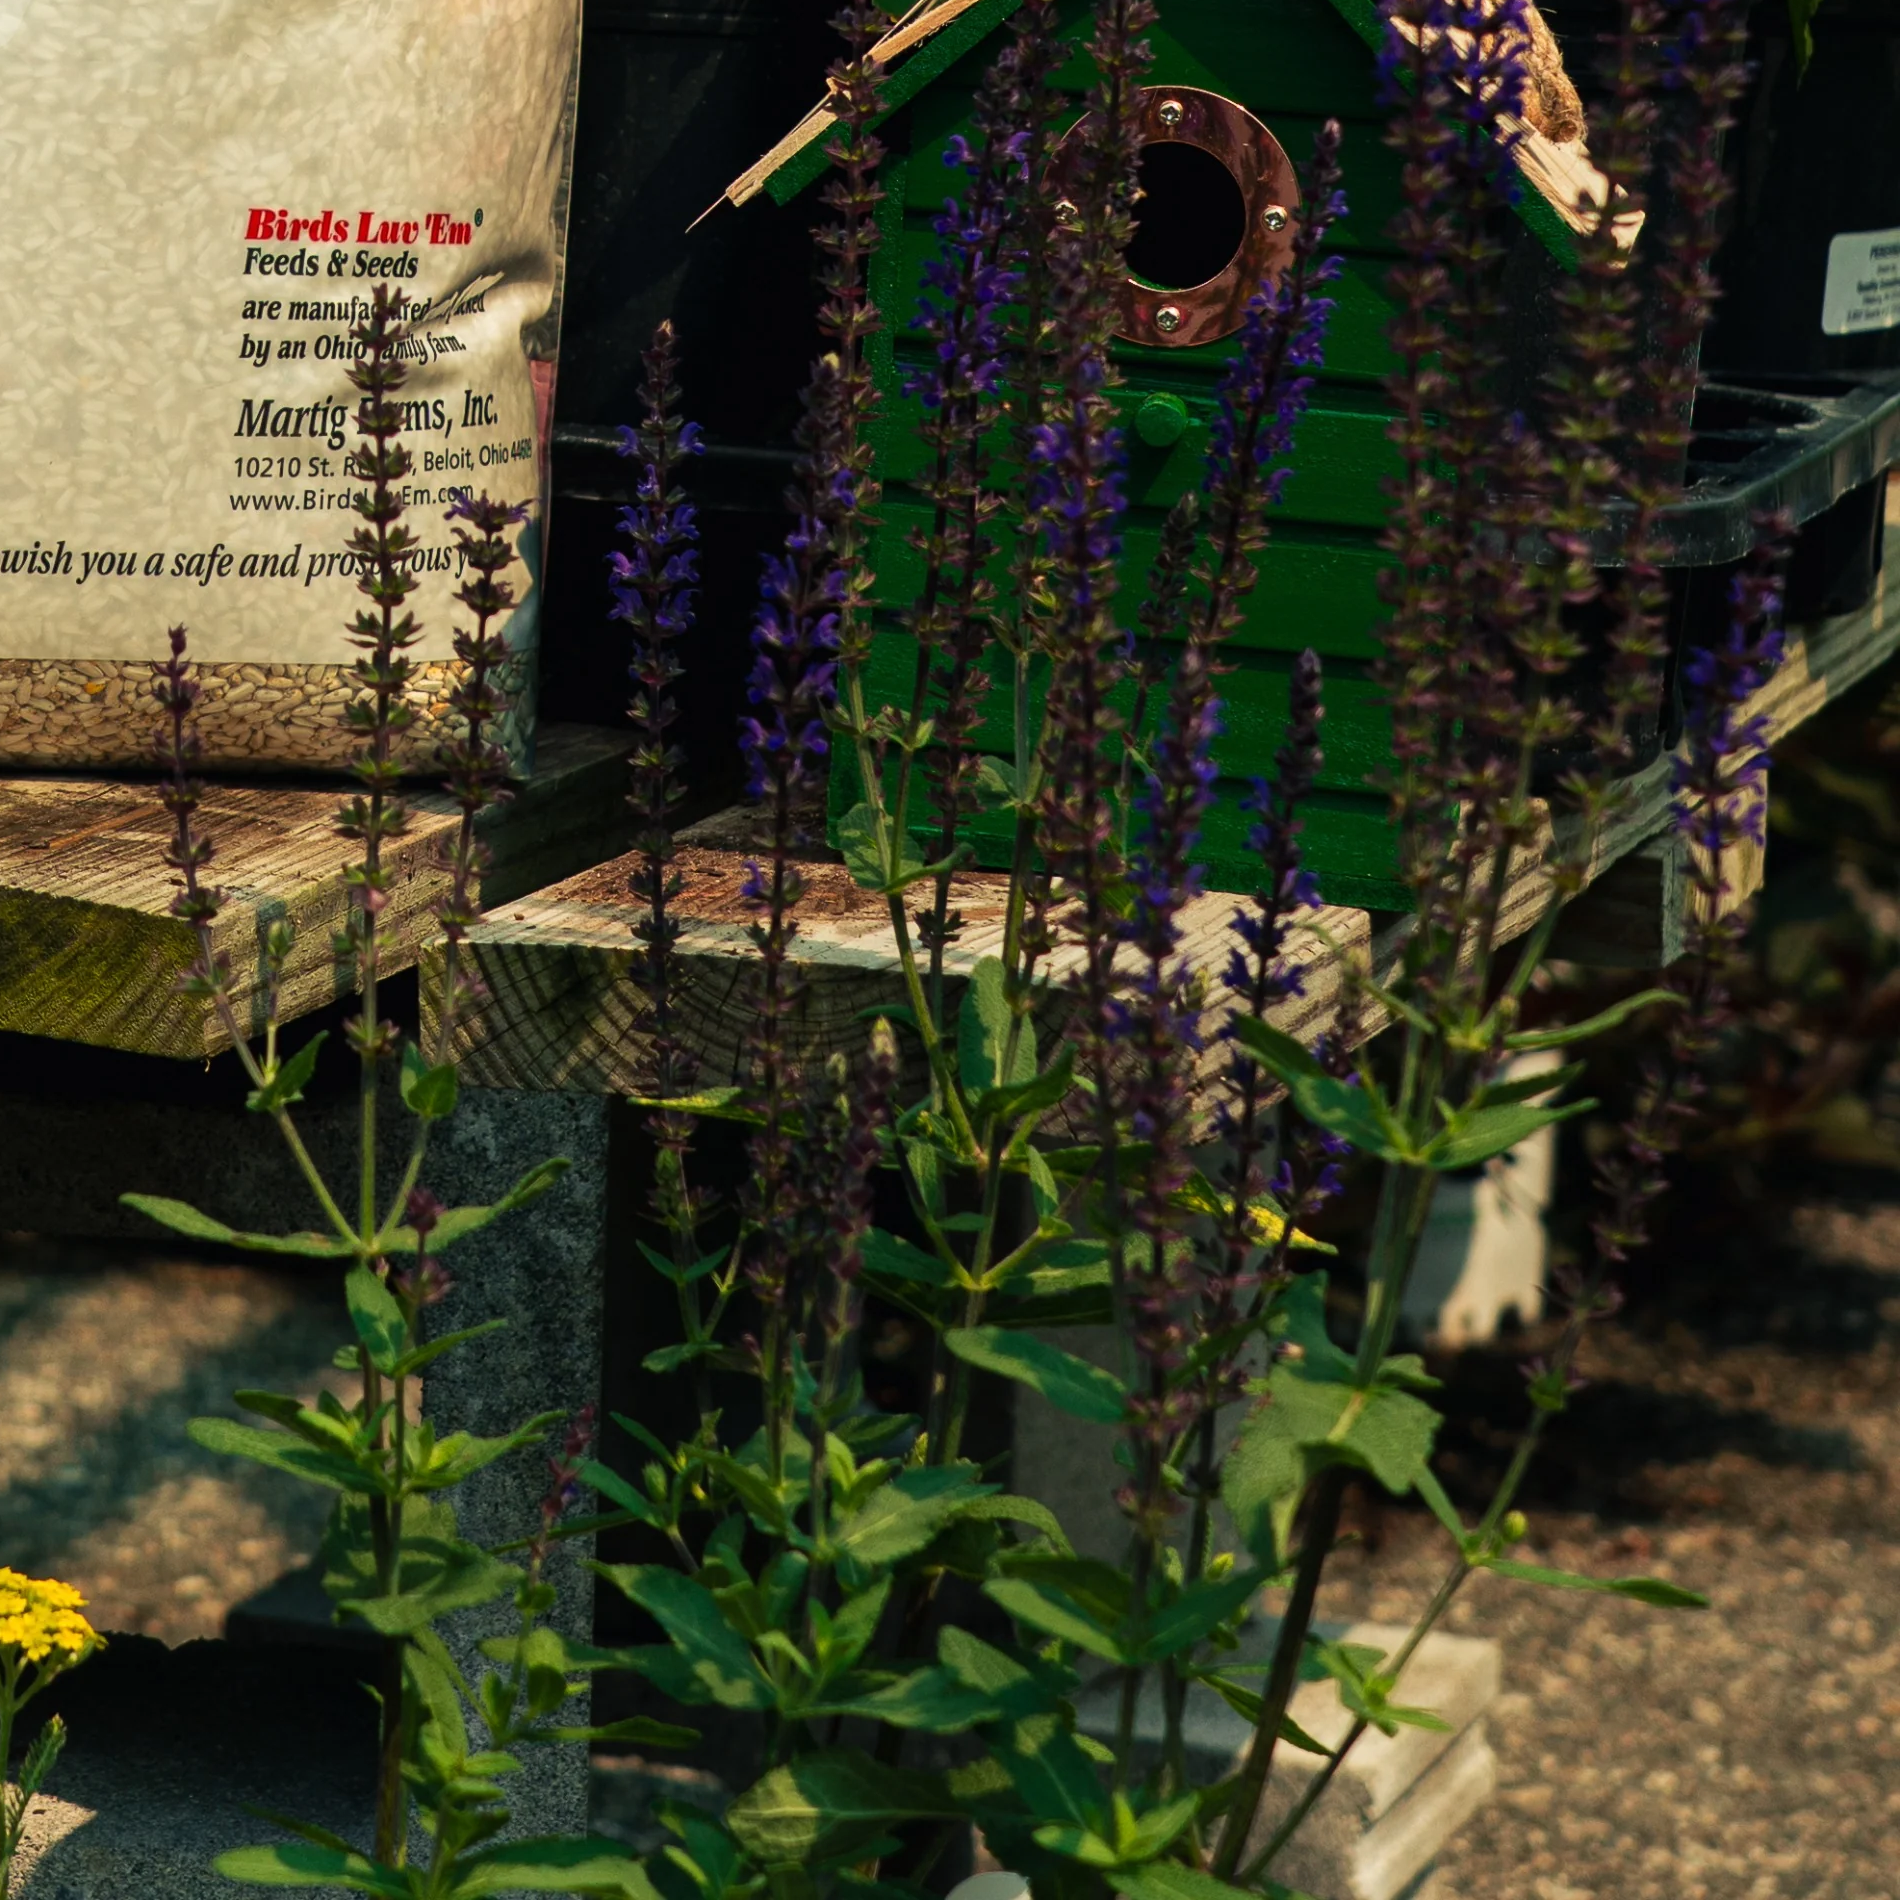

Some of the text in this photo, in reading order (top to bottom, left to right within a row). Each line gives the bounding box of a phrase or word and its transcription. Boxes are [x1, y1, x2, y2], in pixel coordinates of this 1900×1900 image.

[244, 208, 349, 243] Birds
[355, 211, 419, 244] Luv
[242, 247, 419, 279] Feeds & Seeds
[241, 300, 282, 321] are
[239, 332, 467, 368] by an Ohio amily farm.
[234, 396, 349, 451] Martig
[461, 389, 499, 428] Inc.
[234, 457, 301, 479] 10210
[308, 457, 335, 478] St.
[423, 448, 475, 473] Beloit,
[478, 444, 509, 467] Ohio
[0, 540, 74, 577] wish
[76, 546, 138, 585] you
[144, 554, 165, 576] a
[170, 544, 232, 587] safe
[238, 542, 302, 578] and
